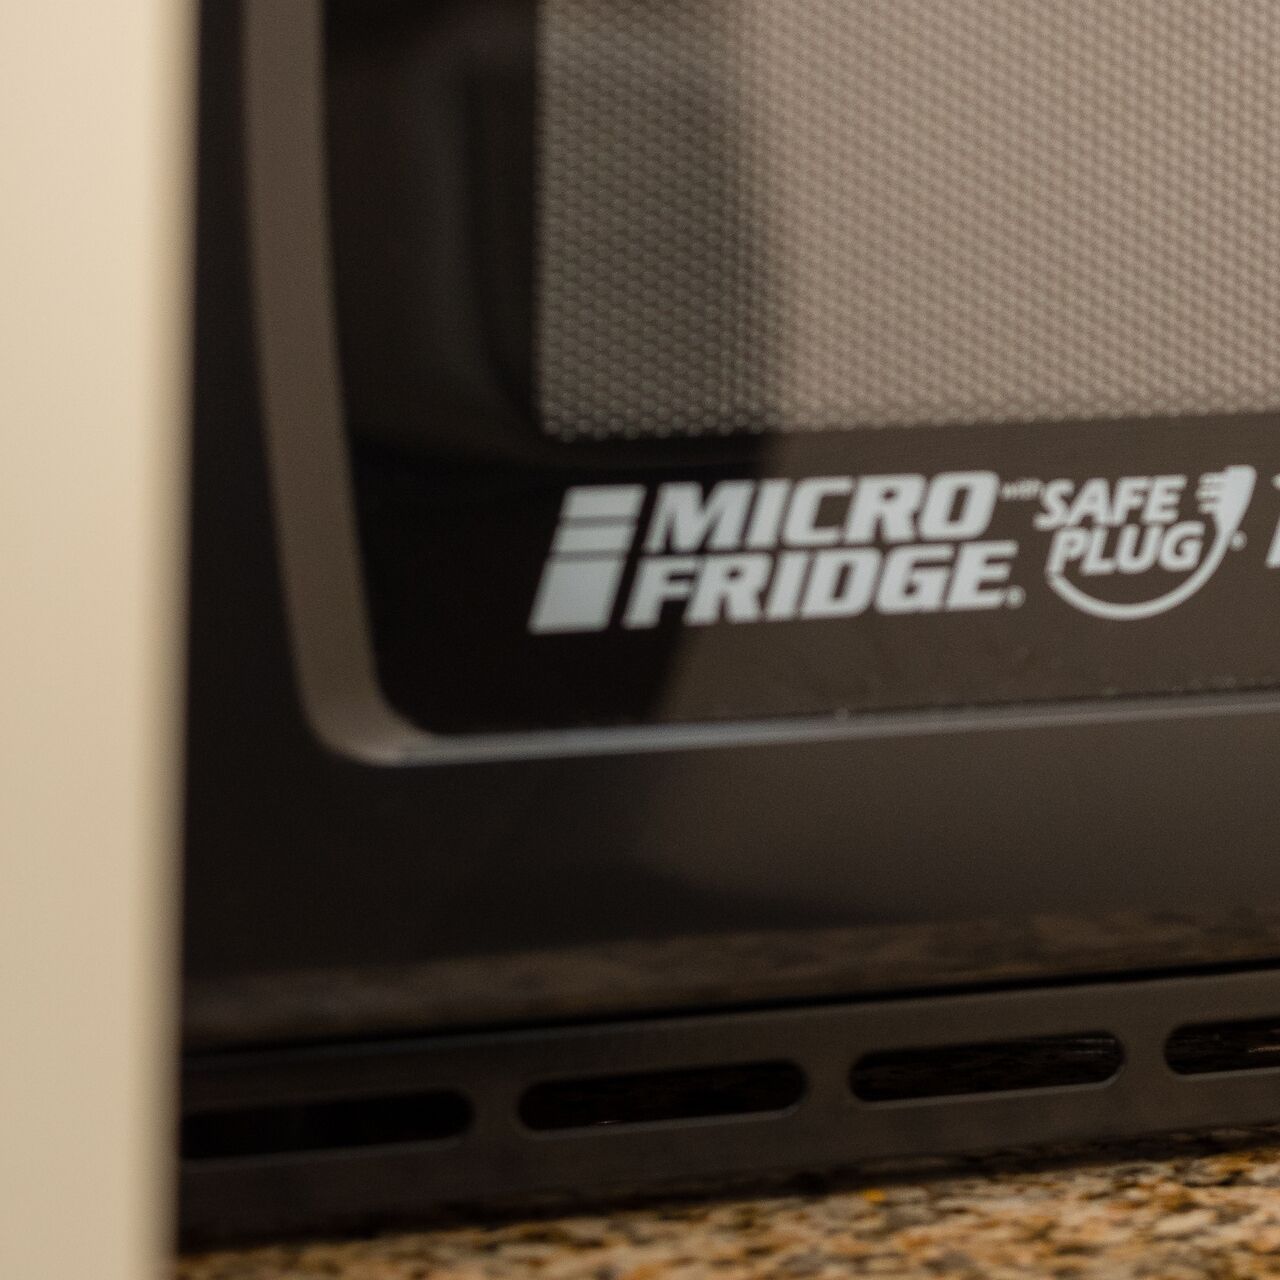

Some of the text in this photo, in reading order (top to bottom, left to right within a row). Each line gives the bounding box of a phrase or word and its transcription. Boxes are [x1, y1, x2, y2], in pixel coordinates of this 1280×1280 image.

[644, 471, 1000, 554] MICRO
[1033, 474, 1187, 531] SAFE
[1044, 520, 1205, 576] PLUG
